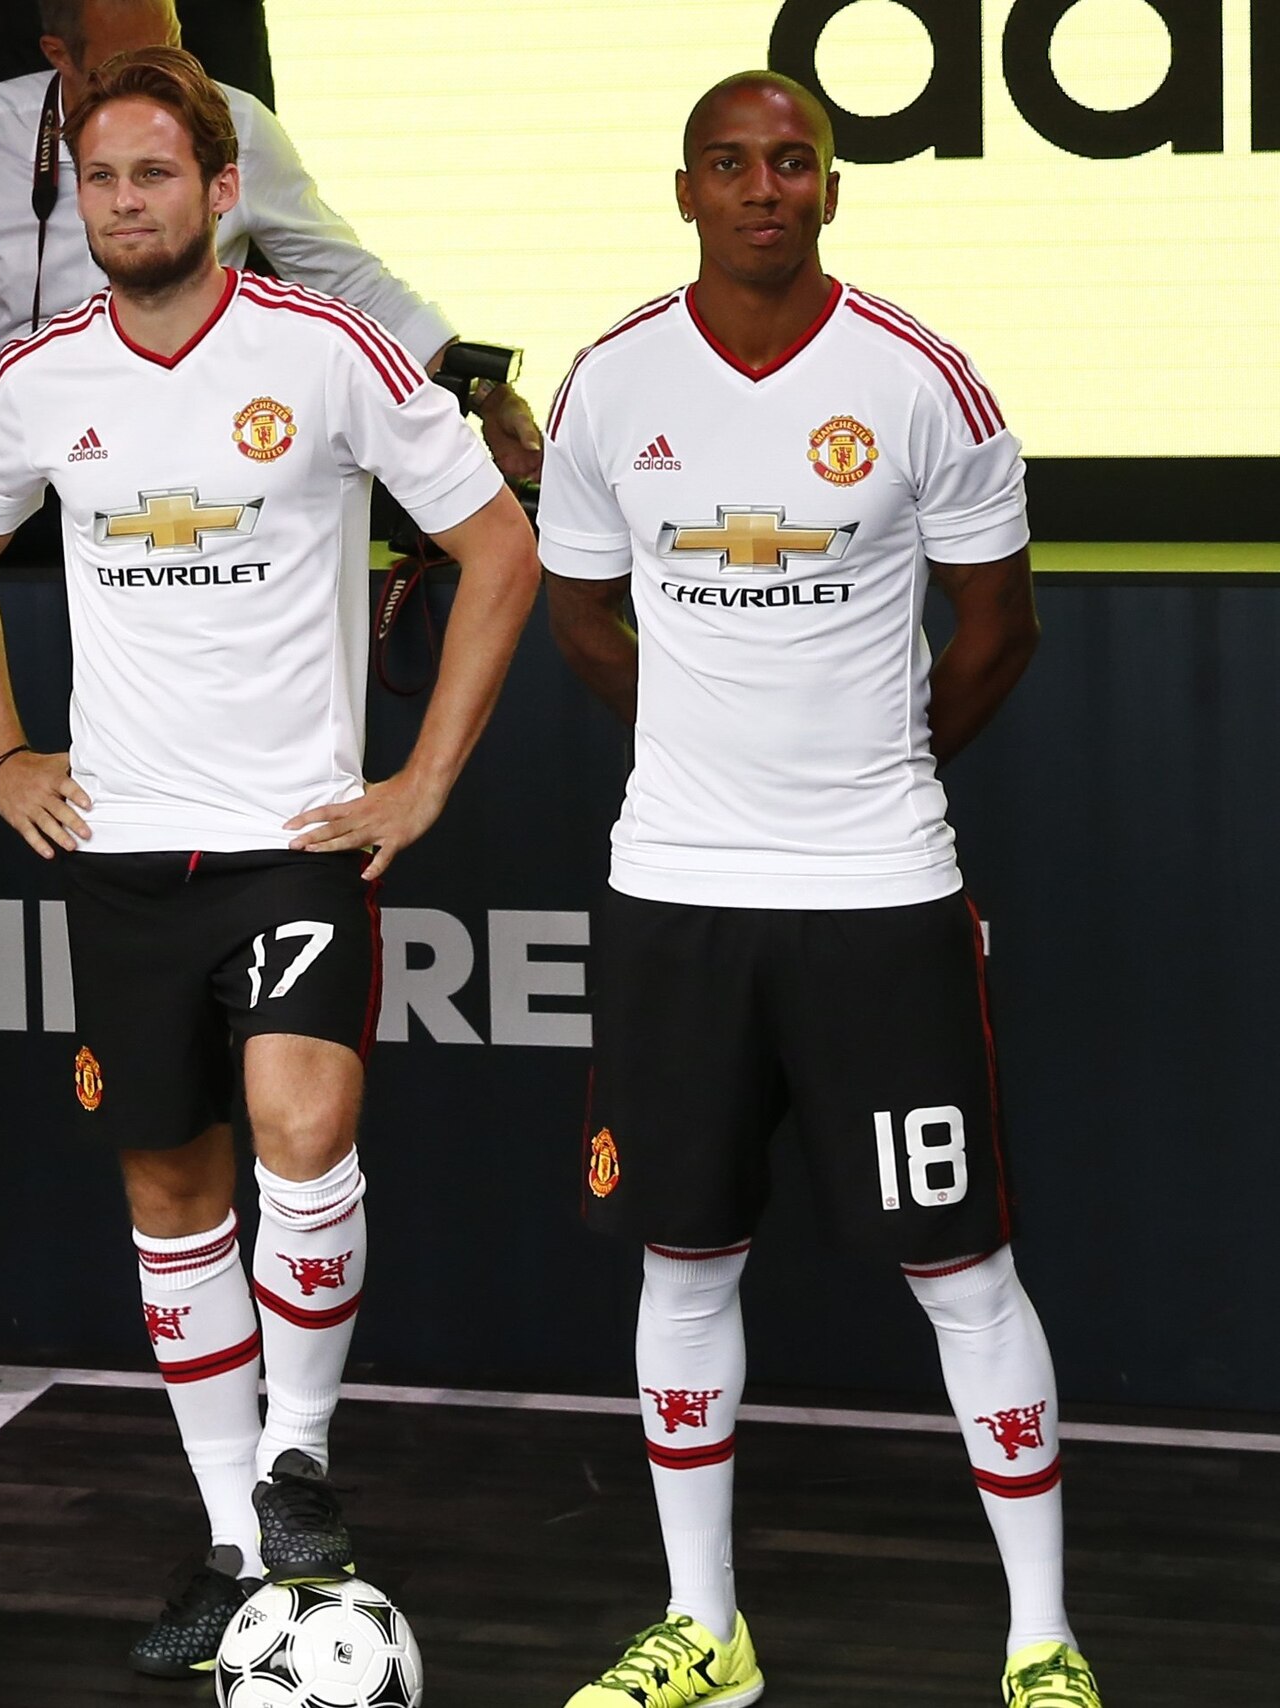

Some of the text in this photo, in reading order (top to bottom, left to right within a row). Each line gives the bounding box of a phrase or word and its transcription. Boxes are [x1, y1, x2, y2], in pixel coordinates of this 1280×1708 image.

[237, 401, 289, 426] MANCHESTER
[814, 420, 871, 445] MANCHESTER
[67, 448, 109, 462] adidas
[246, 446, 285, 460] UNITED
[633, 457, 682, 471] adidas
[823, 469, 865, 483] UNITED
[97, 562, 271, 587] CHEVROLET
[661, 582, 856, 608] CHEVROLET
[379, 579, 406, 640] Canon
[247, 920, 334, 1009] 17
[873, 1105, 968, 1210] 18
